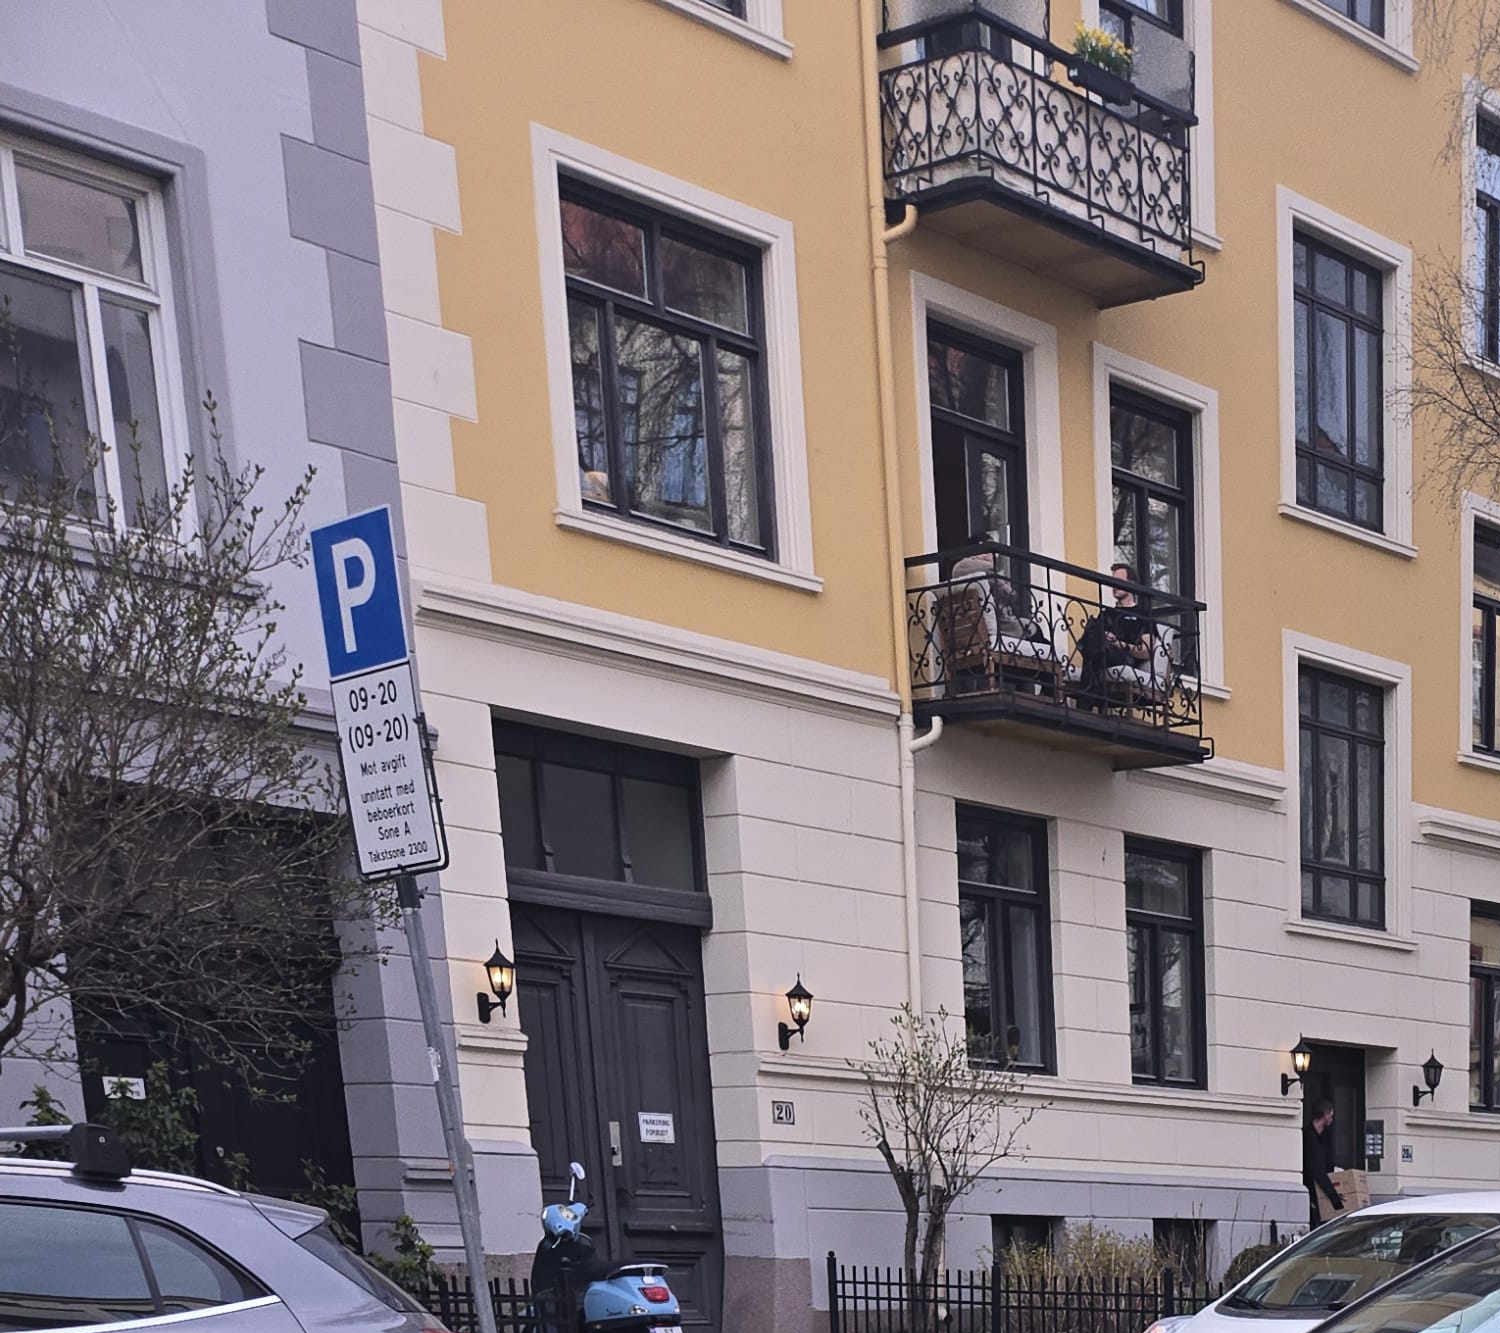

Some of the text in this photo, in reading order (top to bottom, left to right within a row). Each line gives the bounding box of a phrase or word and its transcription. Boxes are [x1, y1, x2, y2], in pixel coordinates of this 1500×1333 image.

[331, 538, 376, 653] P
[349, 680, 397, 712] 09-20
[349, 713, 408, 753] (09-20)
[360, 754, 407, 776] Mot avgift
[361, 779, 415, 804] unntatt med
[367, 801, 415, 823] beboerkort
[378, 821, 411, 840] Sone A
[368, 841, 428, 863] Takstsone 2300
[776, 1104, 792, 1121] 20
